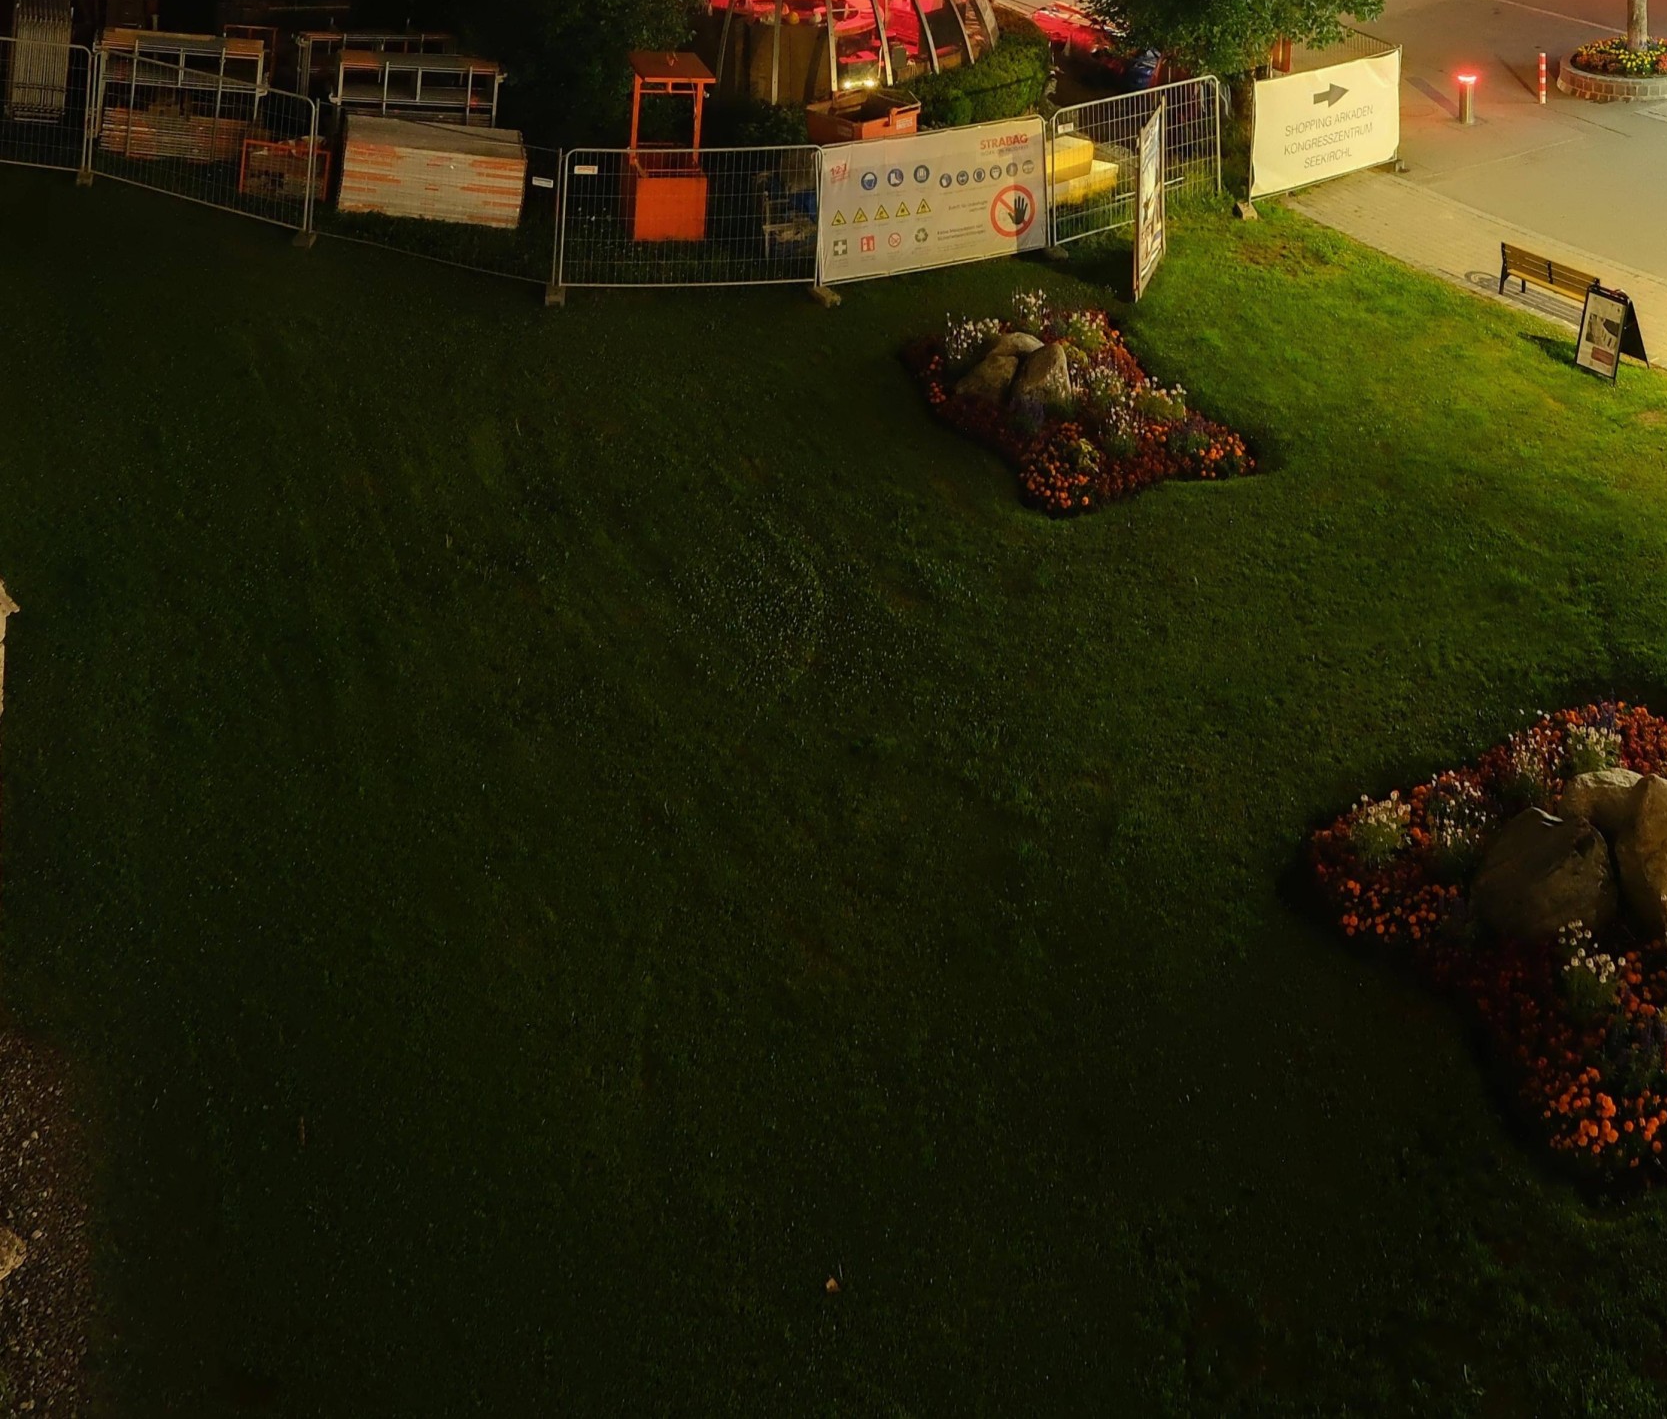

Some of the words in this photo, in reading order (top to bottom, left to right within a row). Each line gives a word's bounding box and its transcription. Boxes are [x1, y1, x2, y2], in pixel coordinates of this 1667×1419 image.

[1285, 116, 1332, 137] SHOPPING
[1333, 104, 1374, 127] ARKADEN
[980, 133, 1029, 150] STRABAG
[1284, 122, 1373, 156] KONGRESSZENTRUM
[1304, 147, 1353, 169] SEEKIRCHL
